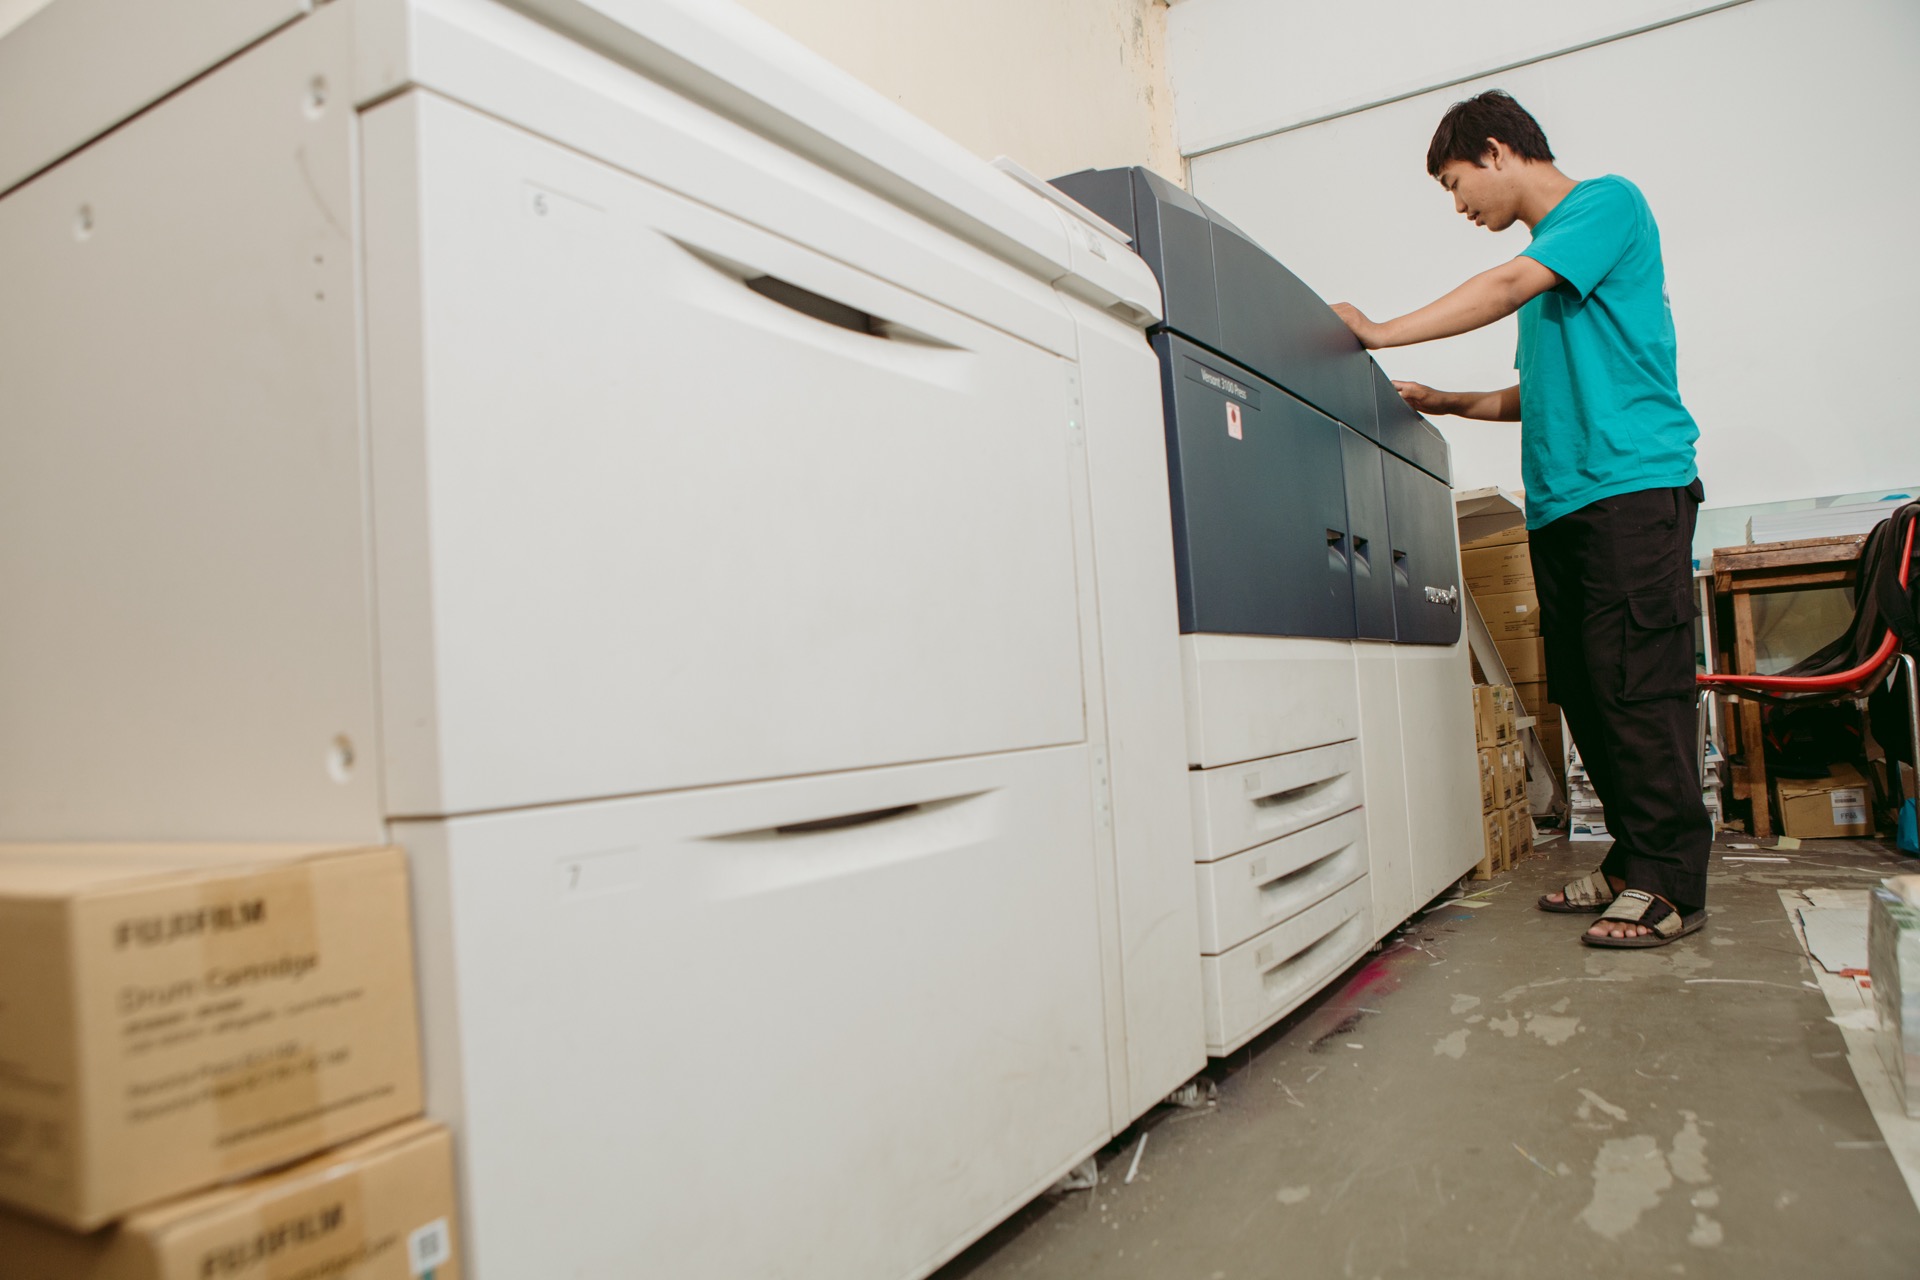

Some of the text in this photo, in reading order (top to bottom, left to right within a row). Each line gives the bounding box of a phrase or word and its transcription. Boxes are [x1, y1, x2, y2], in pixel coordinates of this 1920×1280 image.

[114, 898, 267, 950] FUJIFILM
[204, 950, 319, 994] Cartridge
[200, 1201, 345, 1278] FUJIFILM
